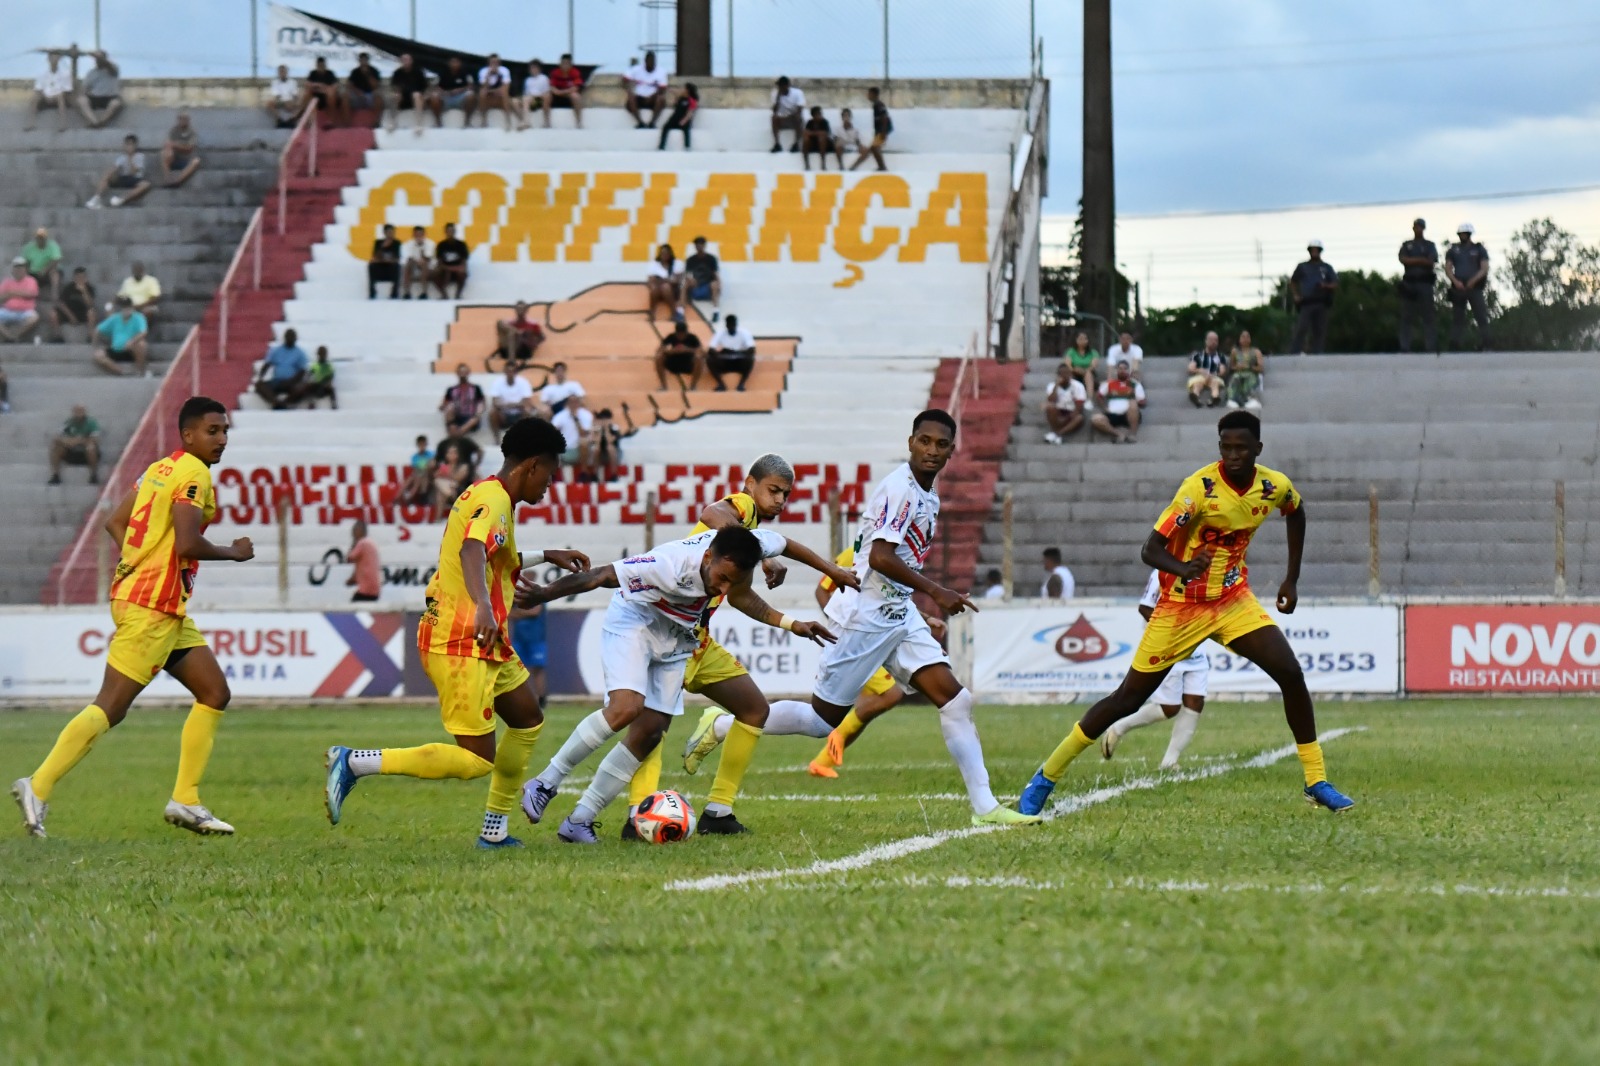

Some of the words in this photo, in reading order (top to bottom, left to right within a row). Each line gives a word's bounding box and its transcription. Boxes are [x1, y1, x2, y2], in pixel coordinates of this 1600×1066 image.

[347, 172, 989, 288] CONFIANÇA
[127, 491, 157, 549] 4
[751, 627, 791, 647] EM
[1061, 636, 1103, 654] DS
[1451, 622, 1600, 667] NOVO
[738, 653, 800, 674] NCE!
[1450, 669, 1600, 686] RESTAURANTE
